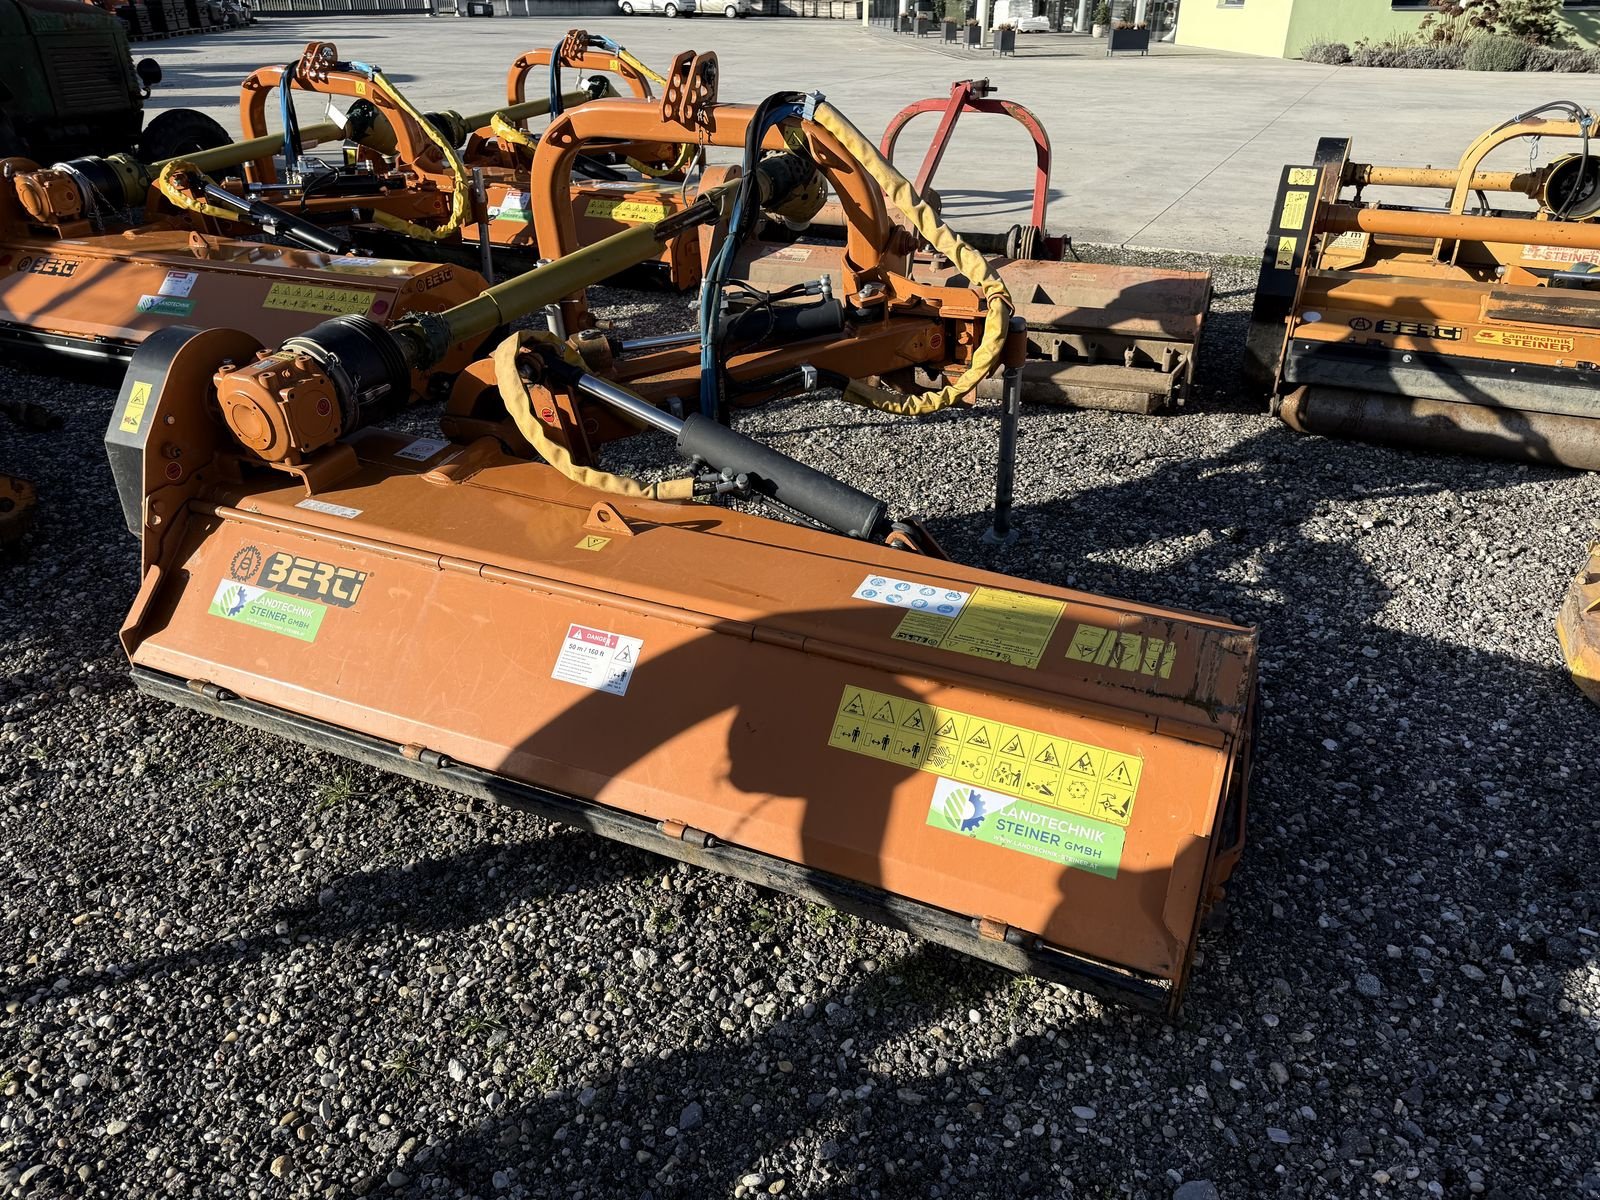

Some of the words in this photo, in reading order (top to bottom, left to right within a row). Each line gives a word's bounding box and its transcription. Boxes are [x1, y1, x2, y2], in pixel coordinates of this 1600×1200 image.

[1502, 332, 1571, 345] Landtechnik
[1502, 338, 1571, 351] STEINER
[249, 605, 287, 623] STEINER
[288, 618, 310, 629] GMBH
[253, 596, 314, 618] LANDTECHNIK
[999, 803, 1106, 843] LANDTECHNIK
[996, 818, 1060, 847] STEINER
[1064, 841, 1102, 859] GMBH
[993, 834, 1099, 870] WWW.LANDTECHNIK-STEINER.AT
